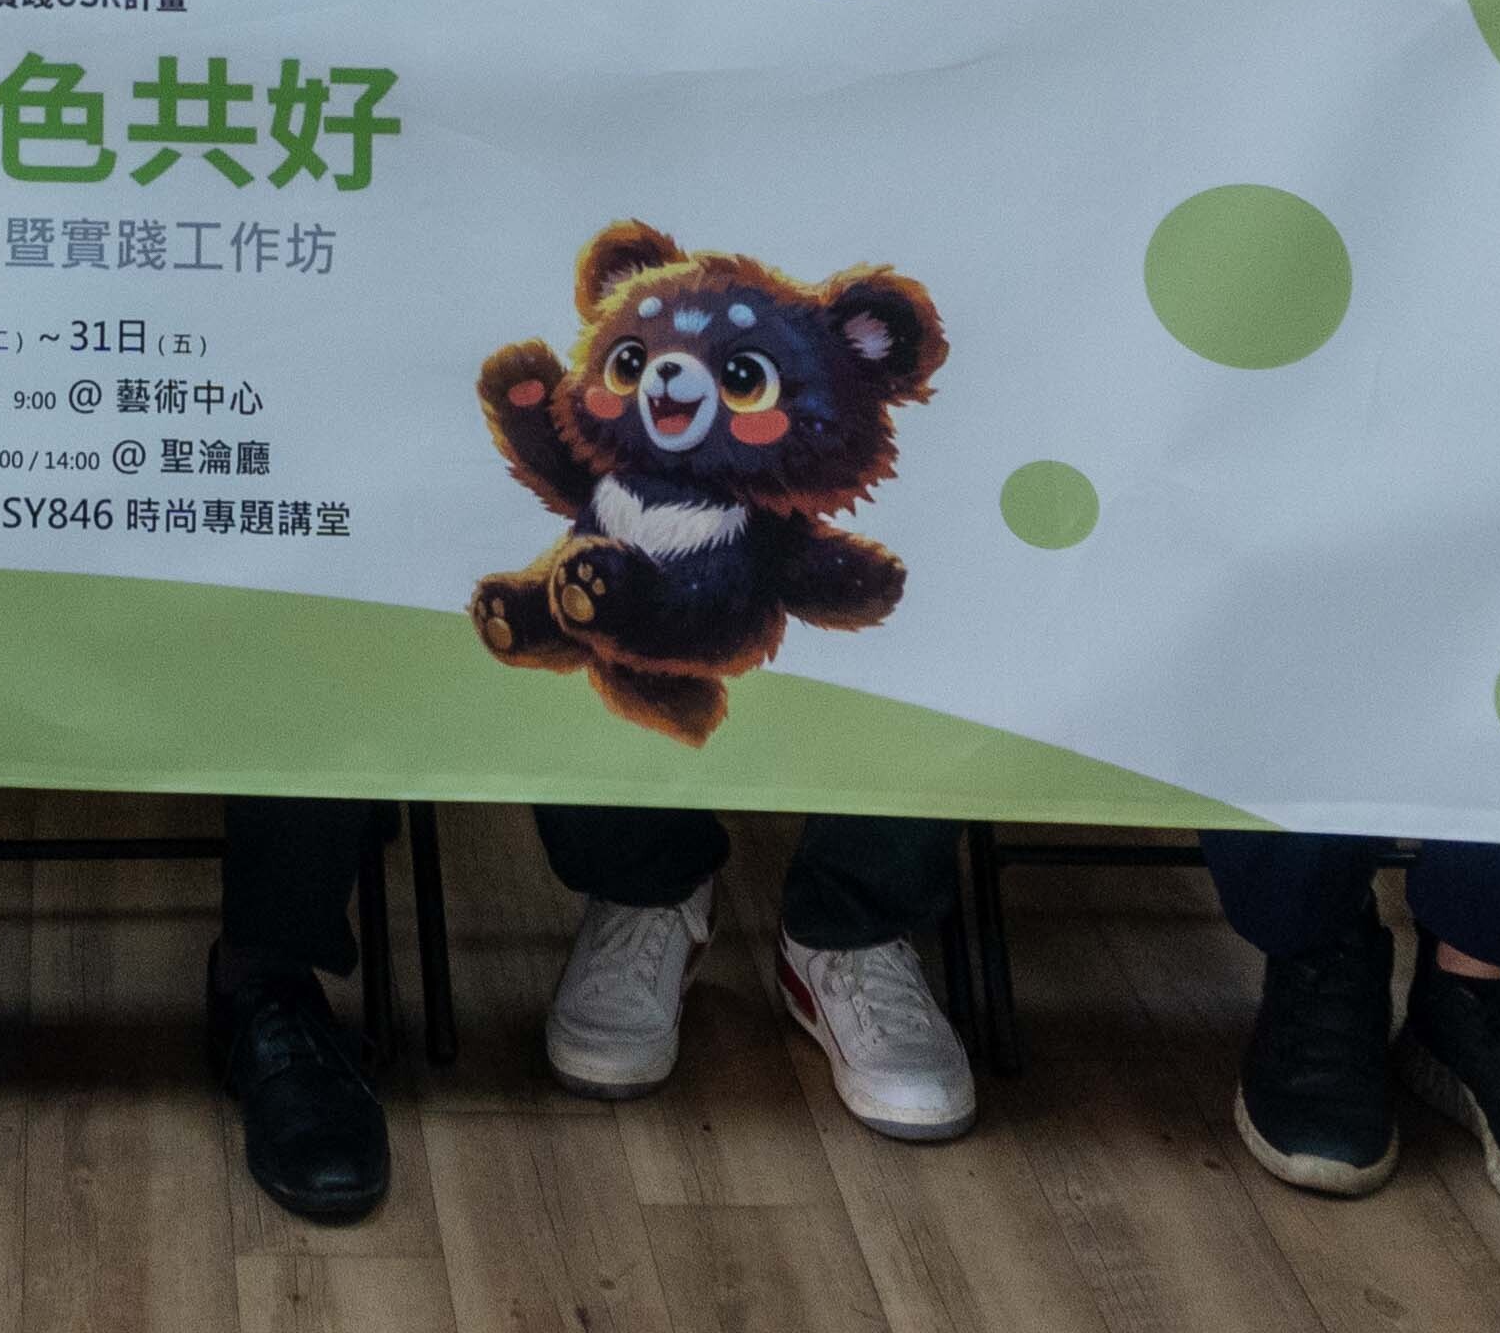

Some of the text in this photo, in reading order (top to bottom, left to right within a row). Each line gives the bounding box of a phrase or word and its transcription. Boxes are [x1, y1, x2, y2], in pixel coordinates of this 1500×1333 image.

[13, 391, 57, 410] 9:00
[68, 379, 102, 414] @
[116, 379, 264, 415] 藝術中心
[44, 451, 101, 471] 14:00
[112, 438, 147, 475] @
[2, 497, 113, 532] SY846
[126, 499, 351, 537] 時尚專題講堂
